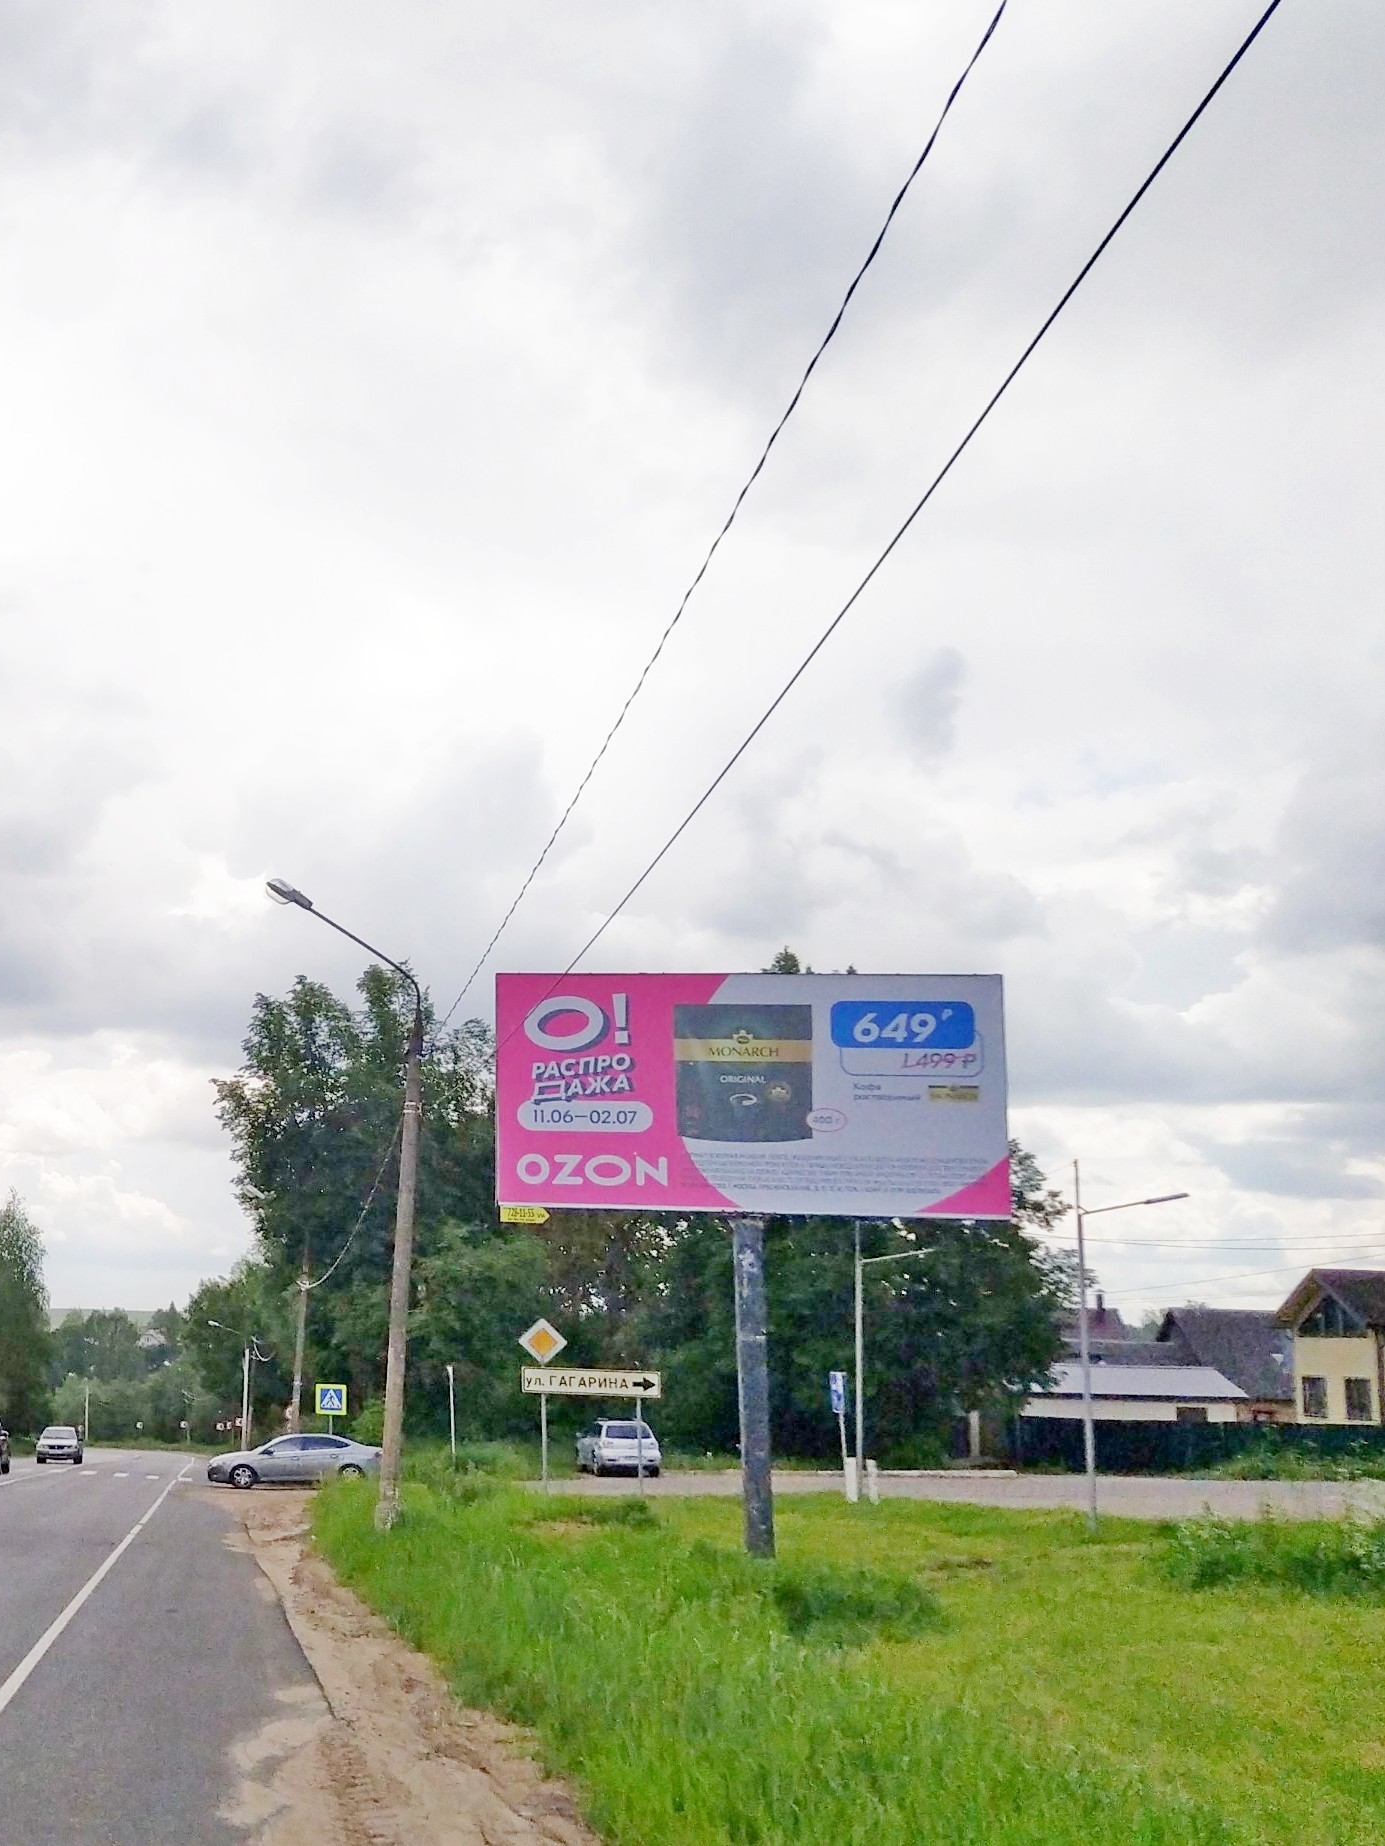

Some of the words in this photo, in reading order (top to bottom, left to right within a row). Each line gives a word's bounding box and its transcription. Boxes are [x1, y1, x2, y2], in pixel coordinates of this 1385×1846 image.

[709, 1046, 779, 1058] MONARCH
[532, 1053, 632, 1080] РАСПРО
[531, 1075, 632, 1102] ДАЖА
[719, 1075, 767, 1084] ORIGINAL
[517, 1152, 669, 1187] OZON
[526, 1377, 545, 1387] ул.
[549, 1375, 629, 1389] ГАГАРИНА
